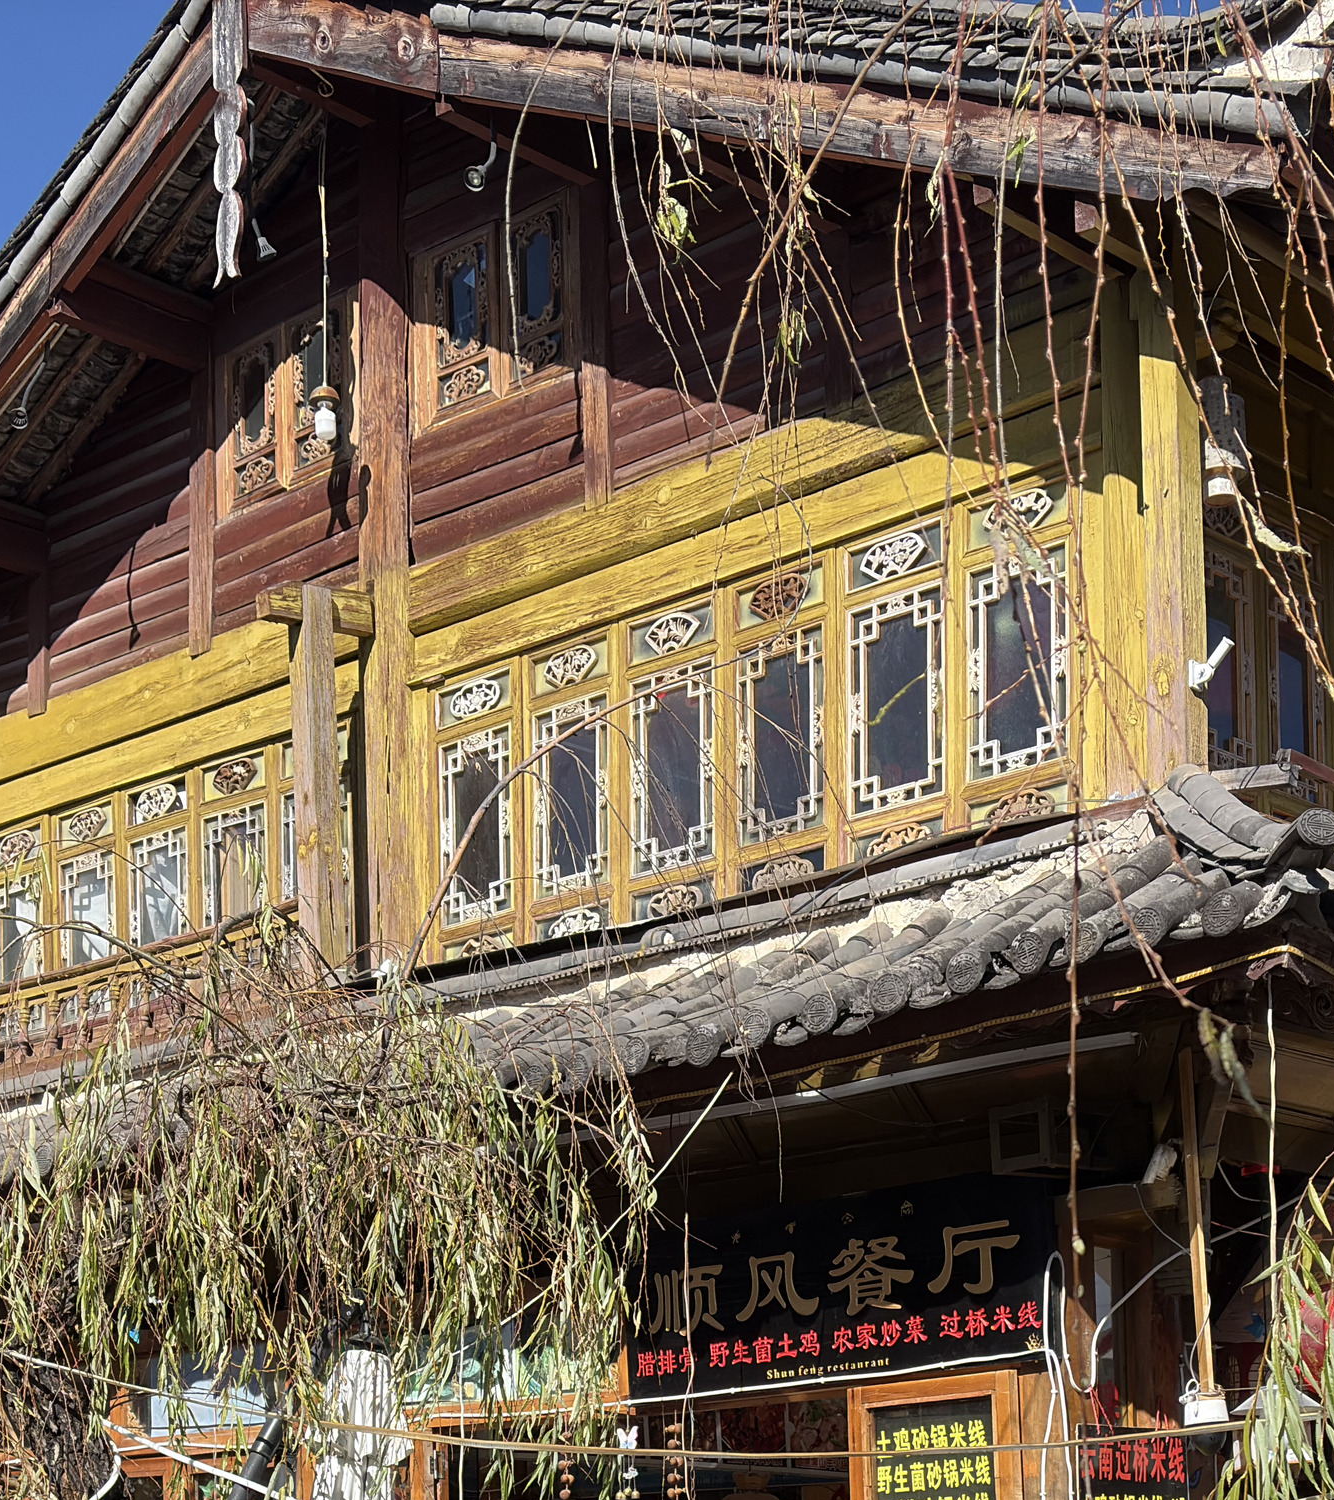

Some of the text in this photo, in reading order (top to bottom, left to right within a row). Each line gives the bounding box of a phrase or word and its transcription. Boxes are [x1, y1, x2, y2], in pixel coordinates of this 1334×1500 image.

[649, 1219, 1021, 1336] 顺风餐厅
[636, 1301, 1043, 1378] 腊排骨 野生菌土鸡 农家炒菜 过桥米线
[766, 1367, 795, 1380] Shun
[876, 1420, 988, 1459] 土鸡砂锅米线
[1080, 1434, 1186, 1483] 云南过桥米线
[877, 1455, 991, 1494] 野生菌砂锅米线
